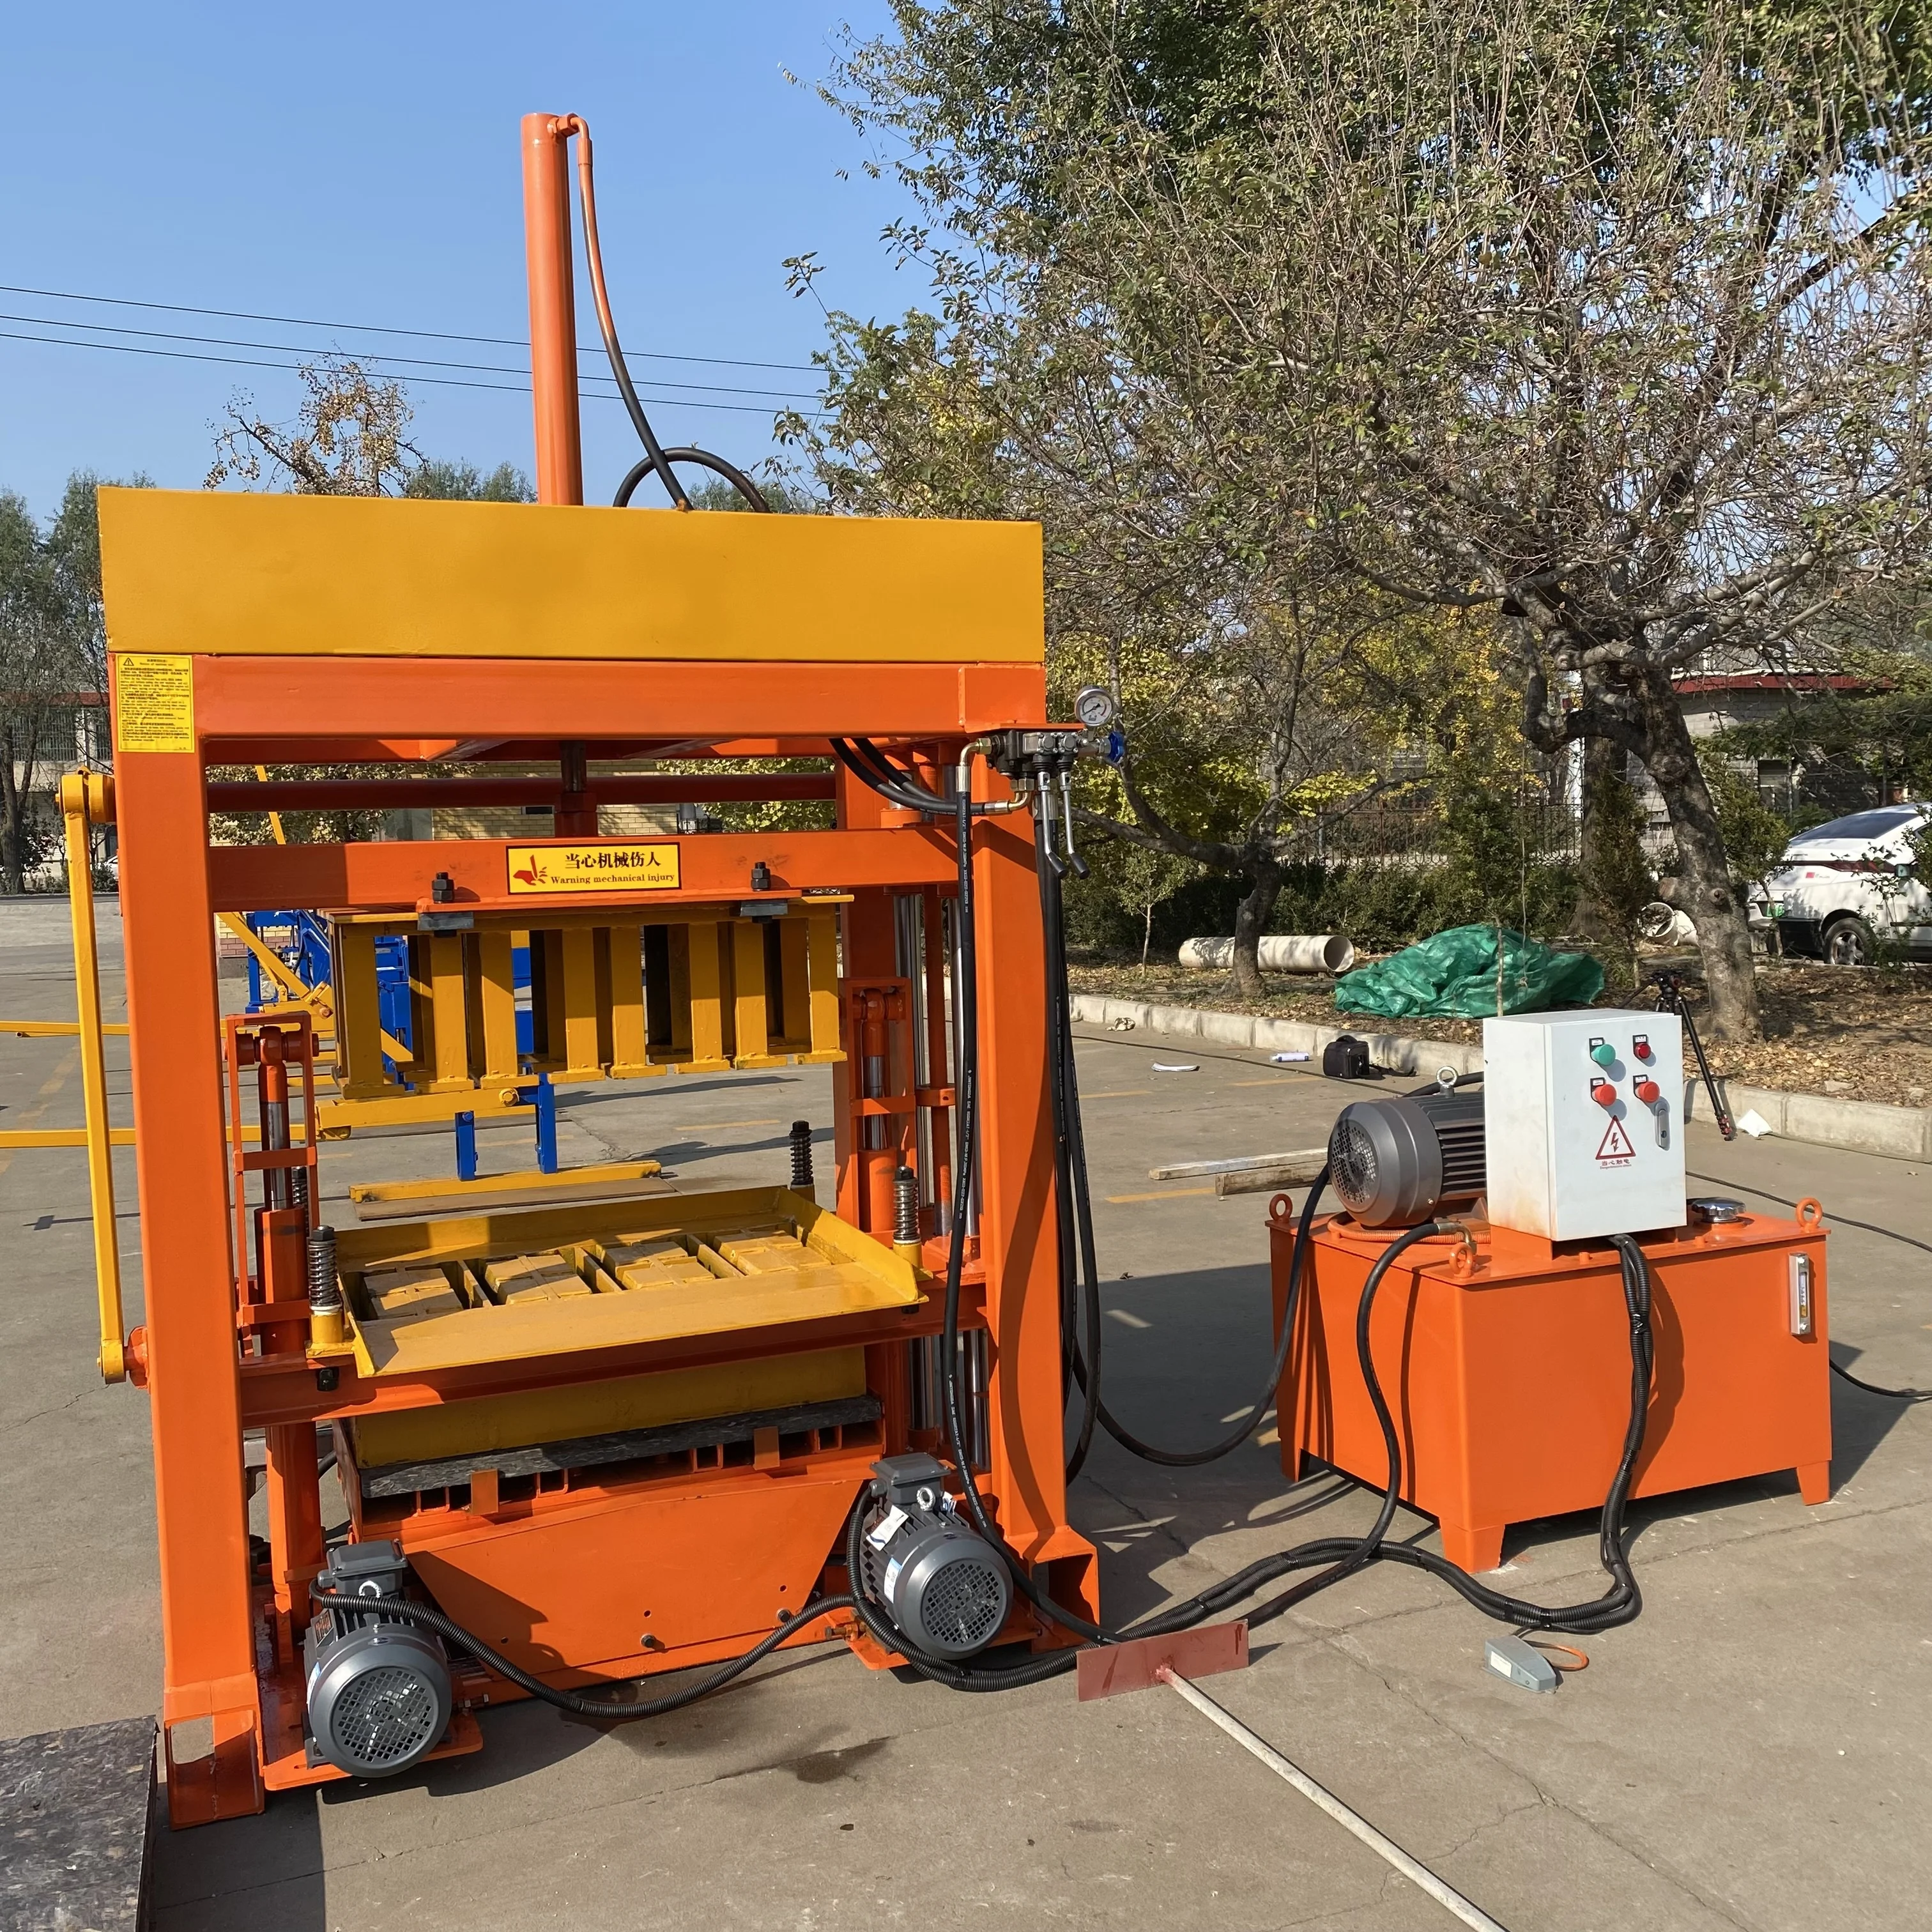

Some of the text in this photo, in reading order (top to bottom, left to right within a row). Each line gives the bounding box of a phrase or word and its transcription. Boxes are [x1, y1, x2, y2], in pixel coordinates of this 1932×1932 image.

[565, 852, 661, 870] 当心机械伤人
[551, 873, 675, 884] Warning mechanical injury
